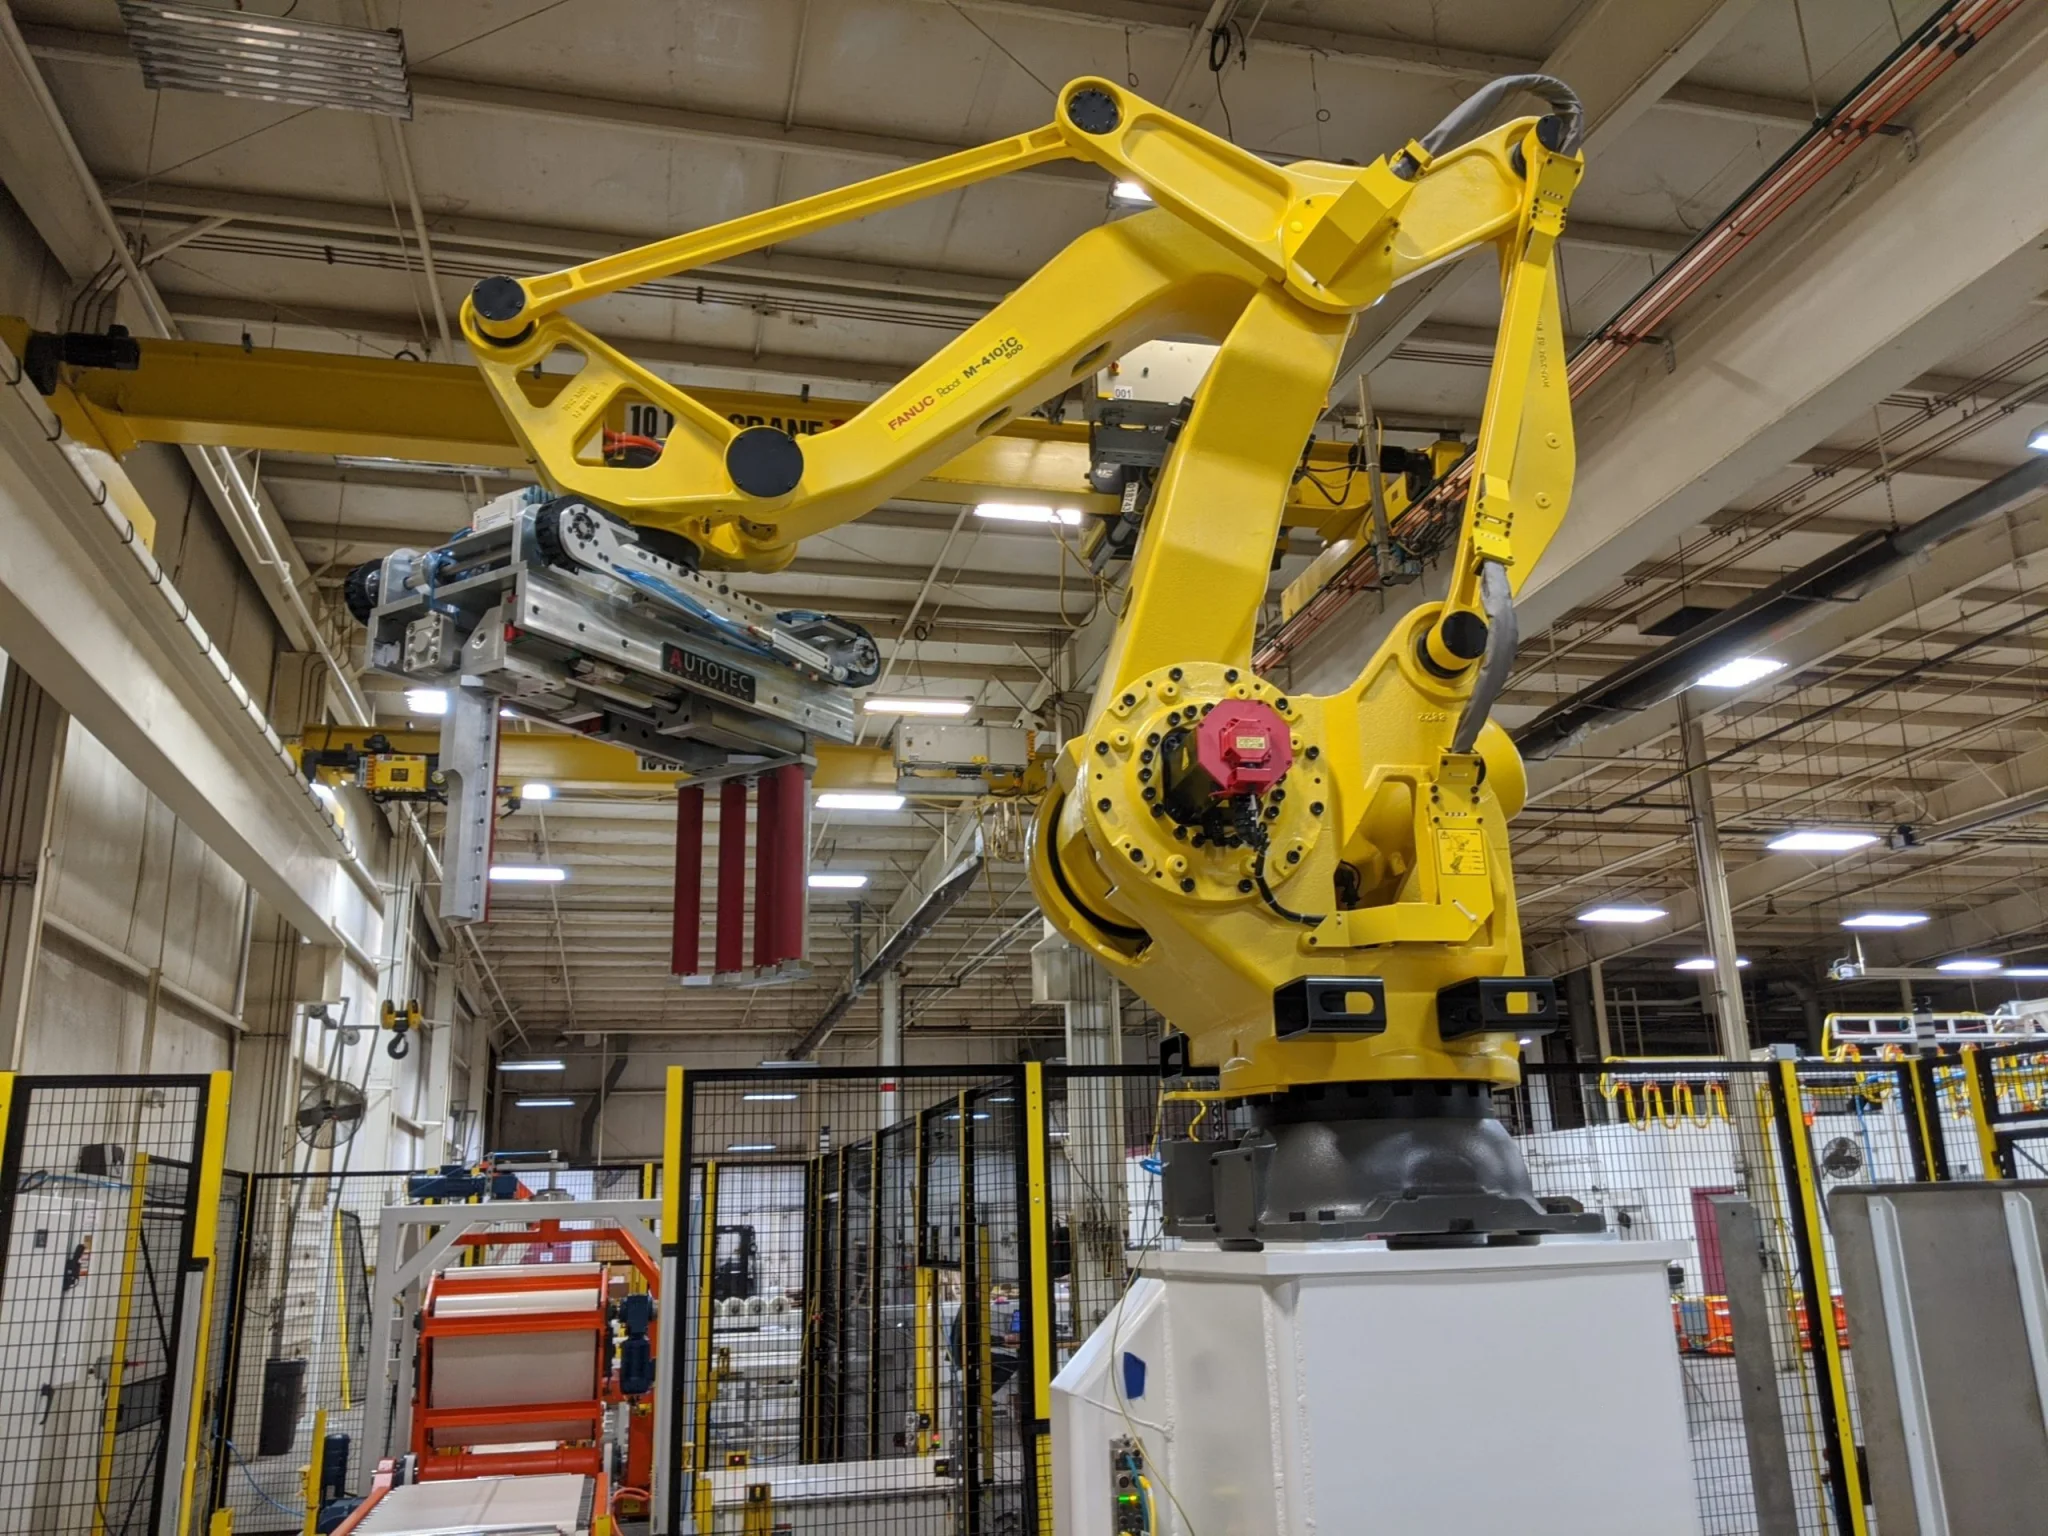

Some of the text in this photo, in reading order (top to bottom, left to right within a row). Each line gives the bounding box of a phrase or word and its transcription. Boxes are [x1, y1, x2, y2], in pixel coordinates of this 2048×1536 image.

[1004, 344, 1024, 359] 500
[888, 395, 935, 431] FANUC
[936, 378, 962, 397] Robot
[1115, 388, 1132, 398] 001
[669, 648, 749, 693] AUTOTEC
